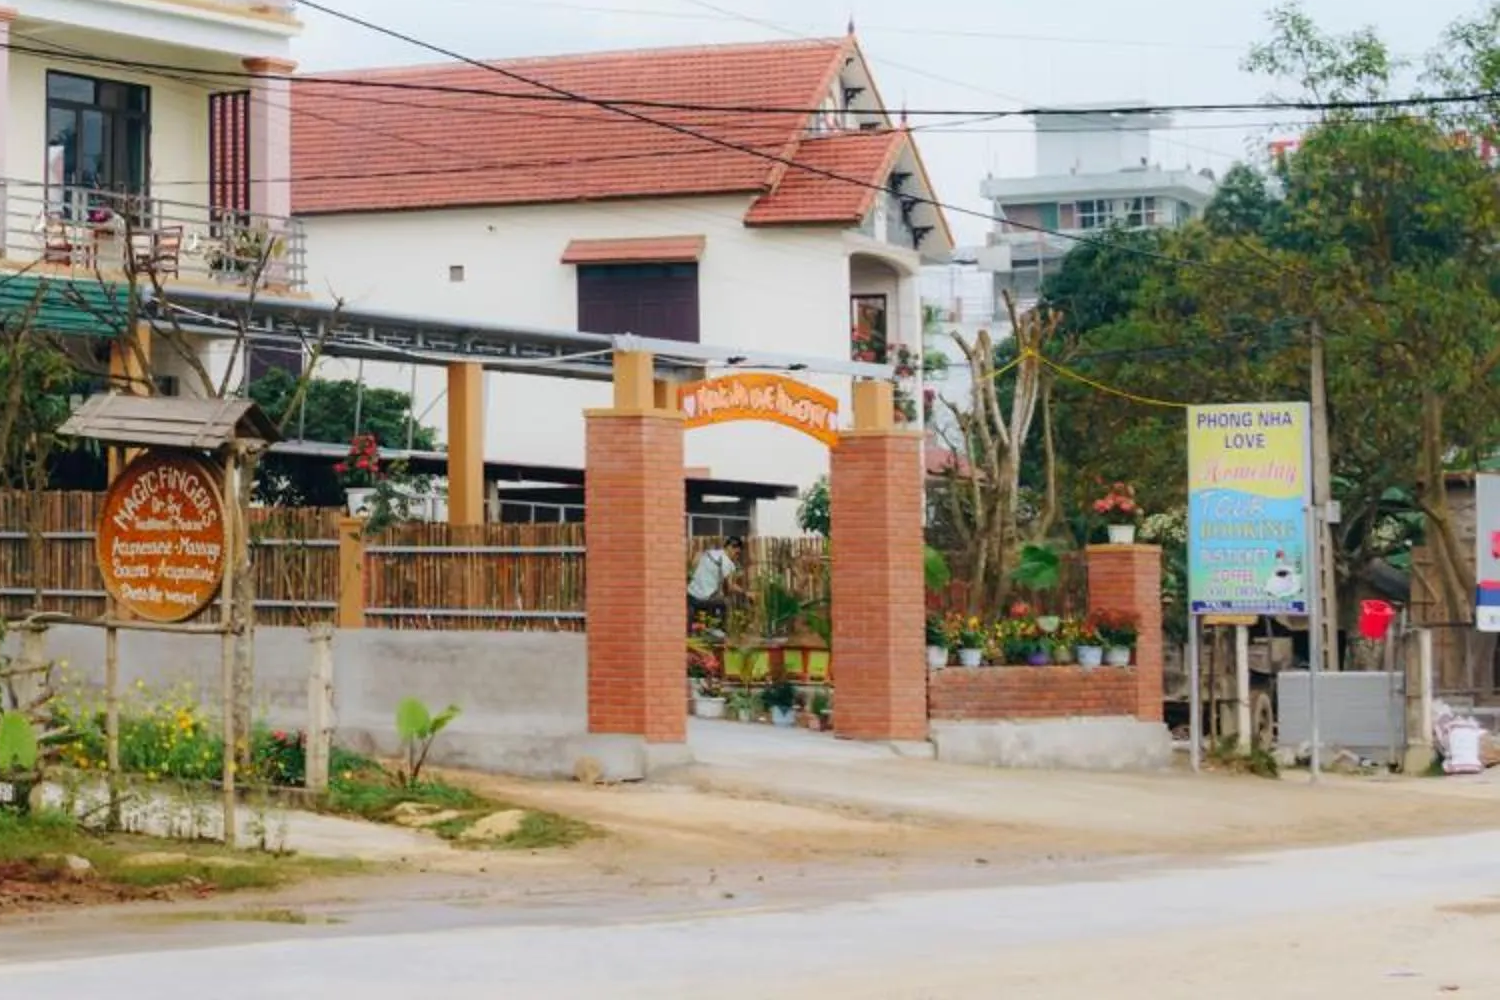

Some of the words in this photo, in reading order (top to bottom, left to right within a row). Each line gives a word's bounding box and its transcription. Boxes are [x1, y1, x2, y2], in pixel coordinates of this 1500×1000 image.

[1197, 412, 1253, 429] PHONG
[1258, 411, 1293, 426] NHA
[1224, 433, 1266, 449] LOVE
